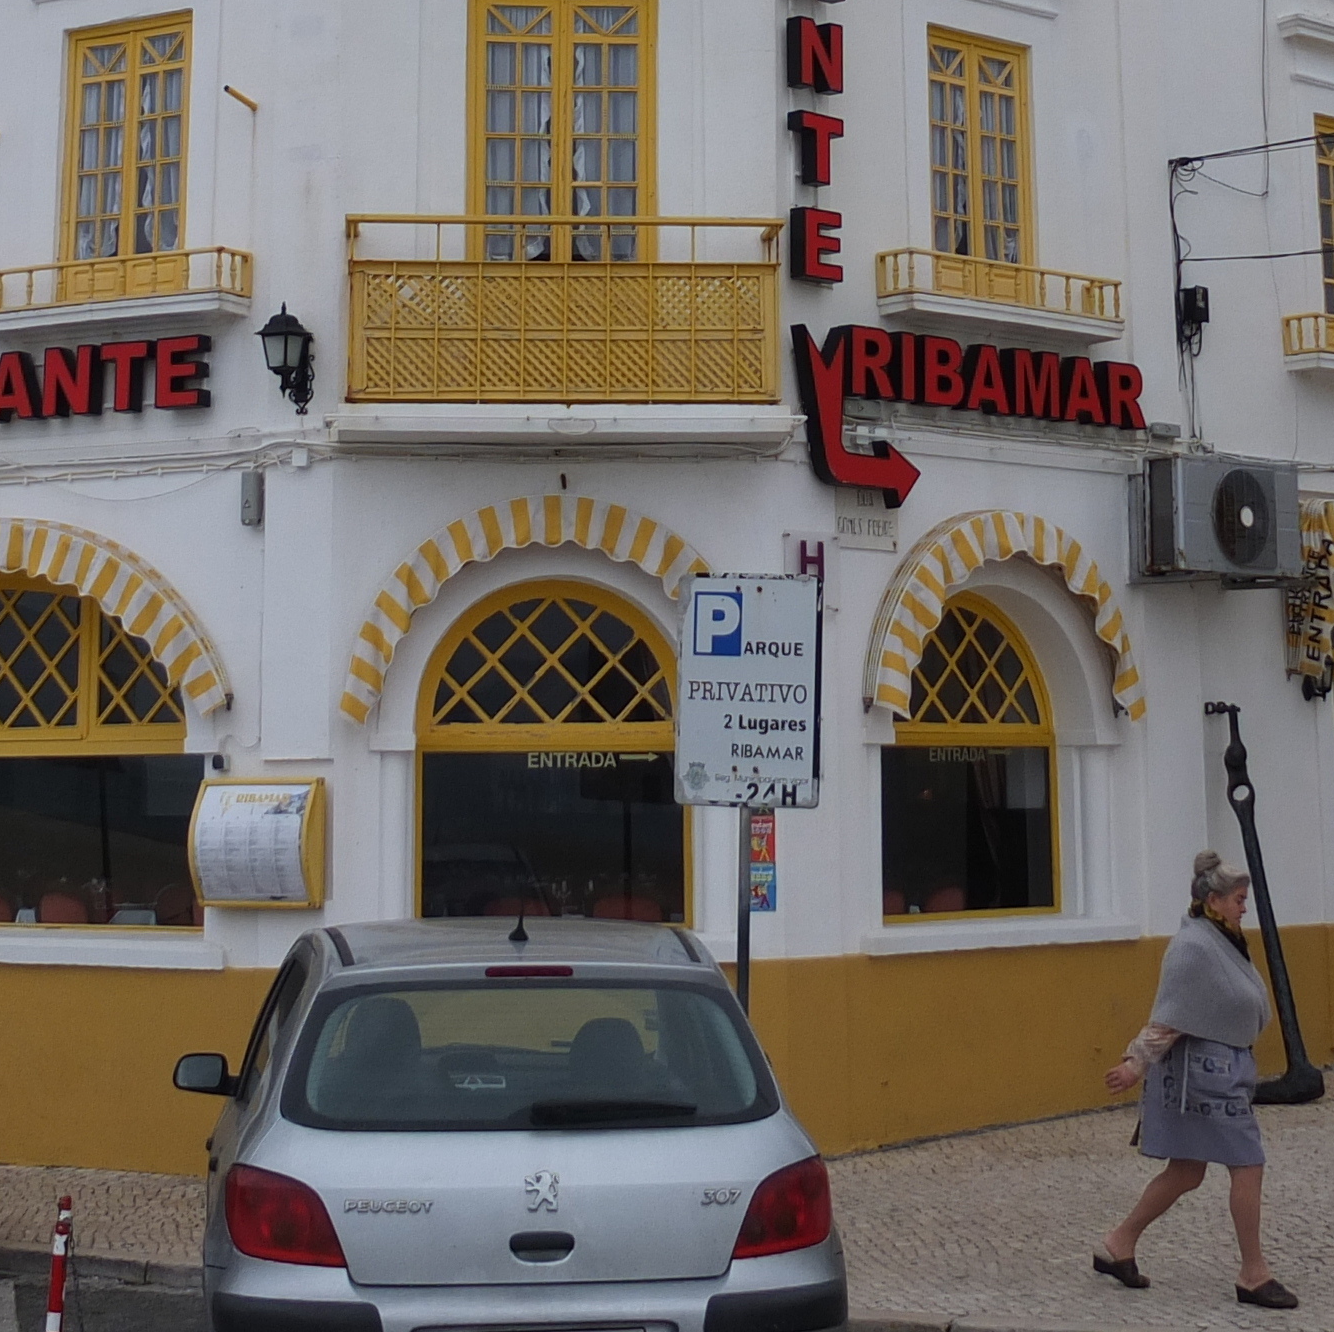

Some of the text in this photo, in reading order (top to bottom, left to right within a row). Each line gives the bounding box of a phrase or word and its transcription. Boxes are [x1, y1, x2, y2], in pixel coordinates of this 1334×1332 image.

[845, 324, 1147, 430] RIBAMAR
[1306, 538, 1334, 662] ENTRADA
[688, 680, 808, 705] PRIVATIVO
[723, 714, 807, 734] 2 Lugares
[527, 752, 617, 769] ENTRADA
[731, 743, 804, 761] RIBAMAR
[929, 747, 986, 763] ENTRADA
[701, 1188, 742, 1206] 307
[343, 1198, 435, 1215] PEUGEOT
